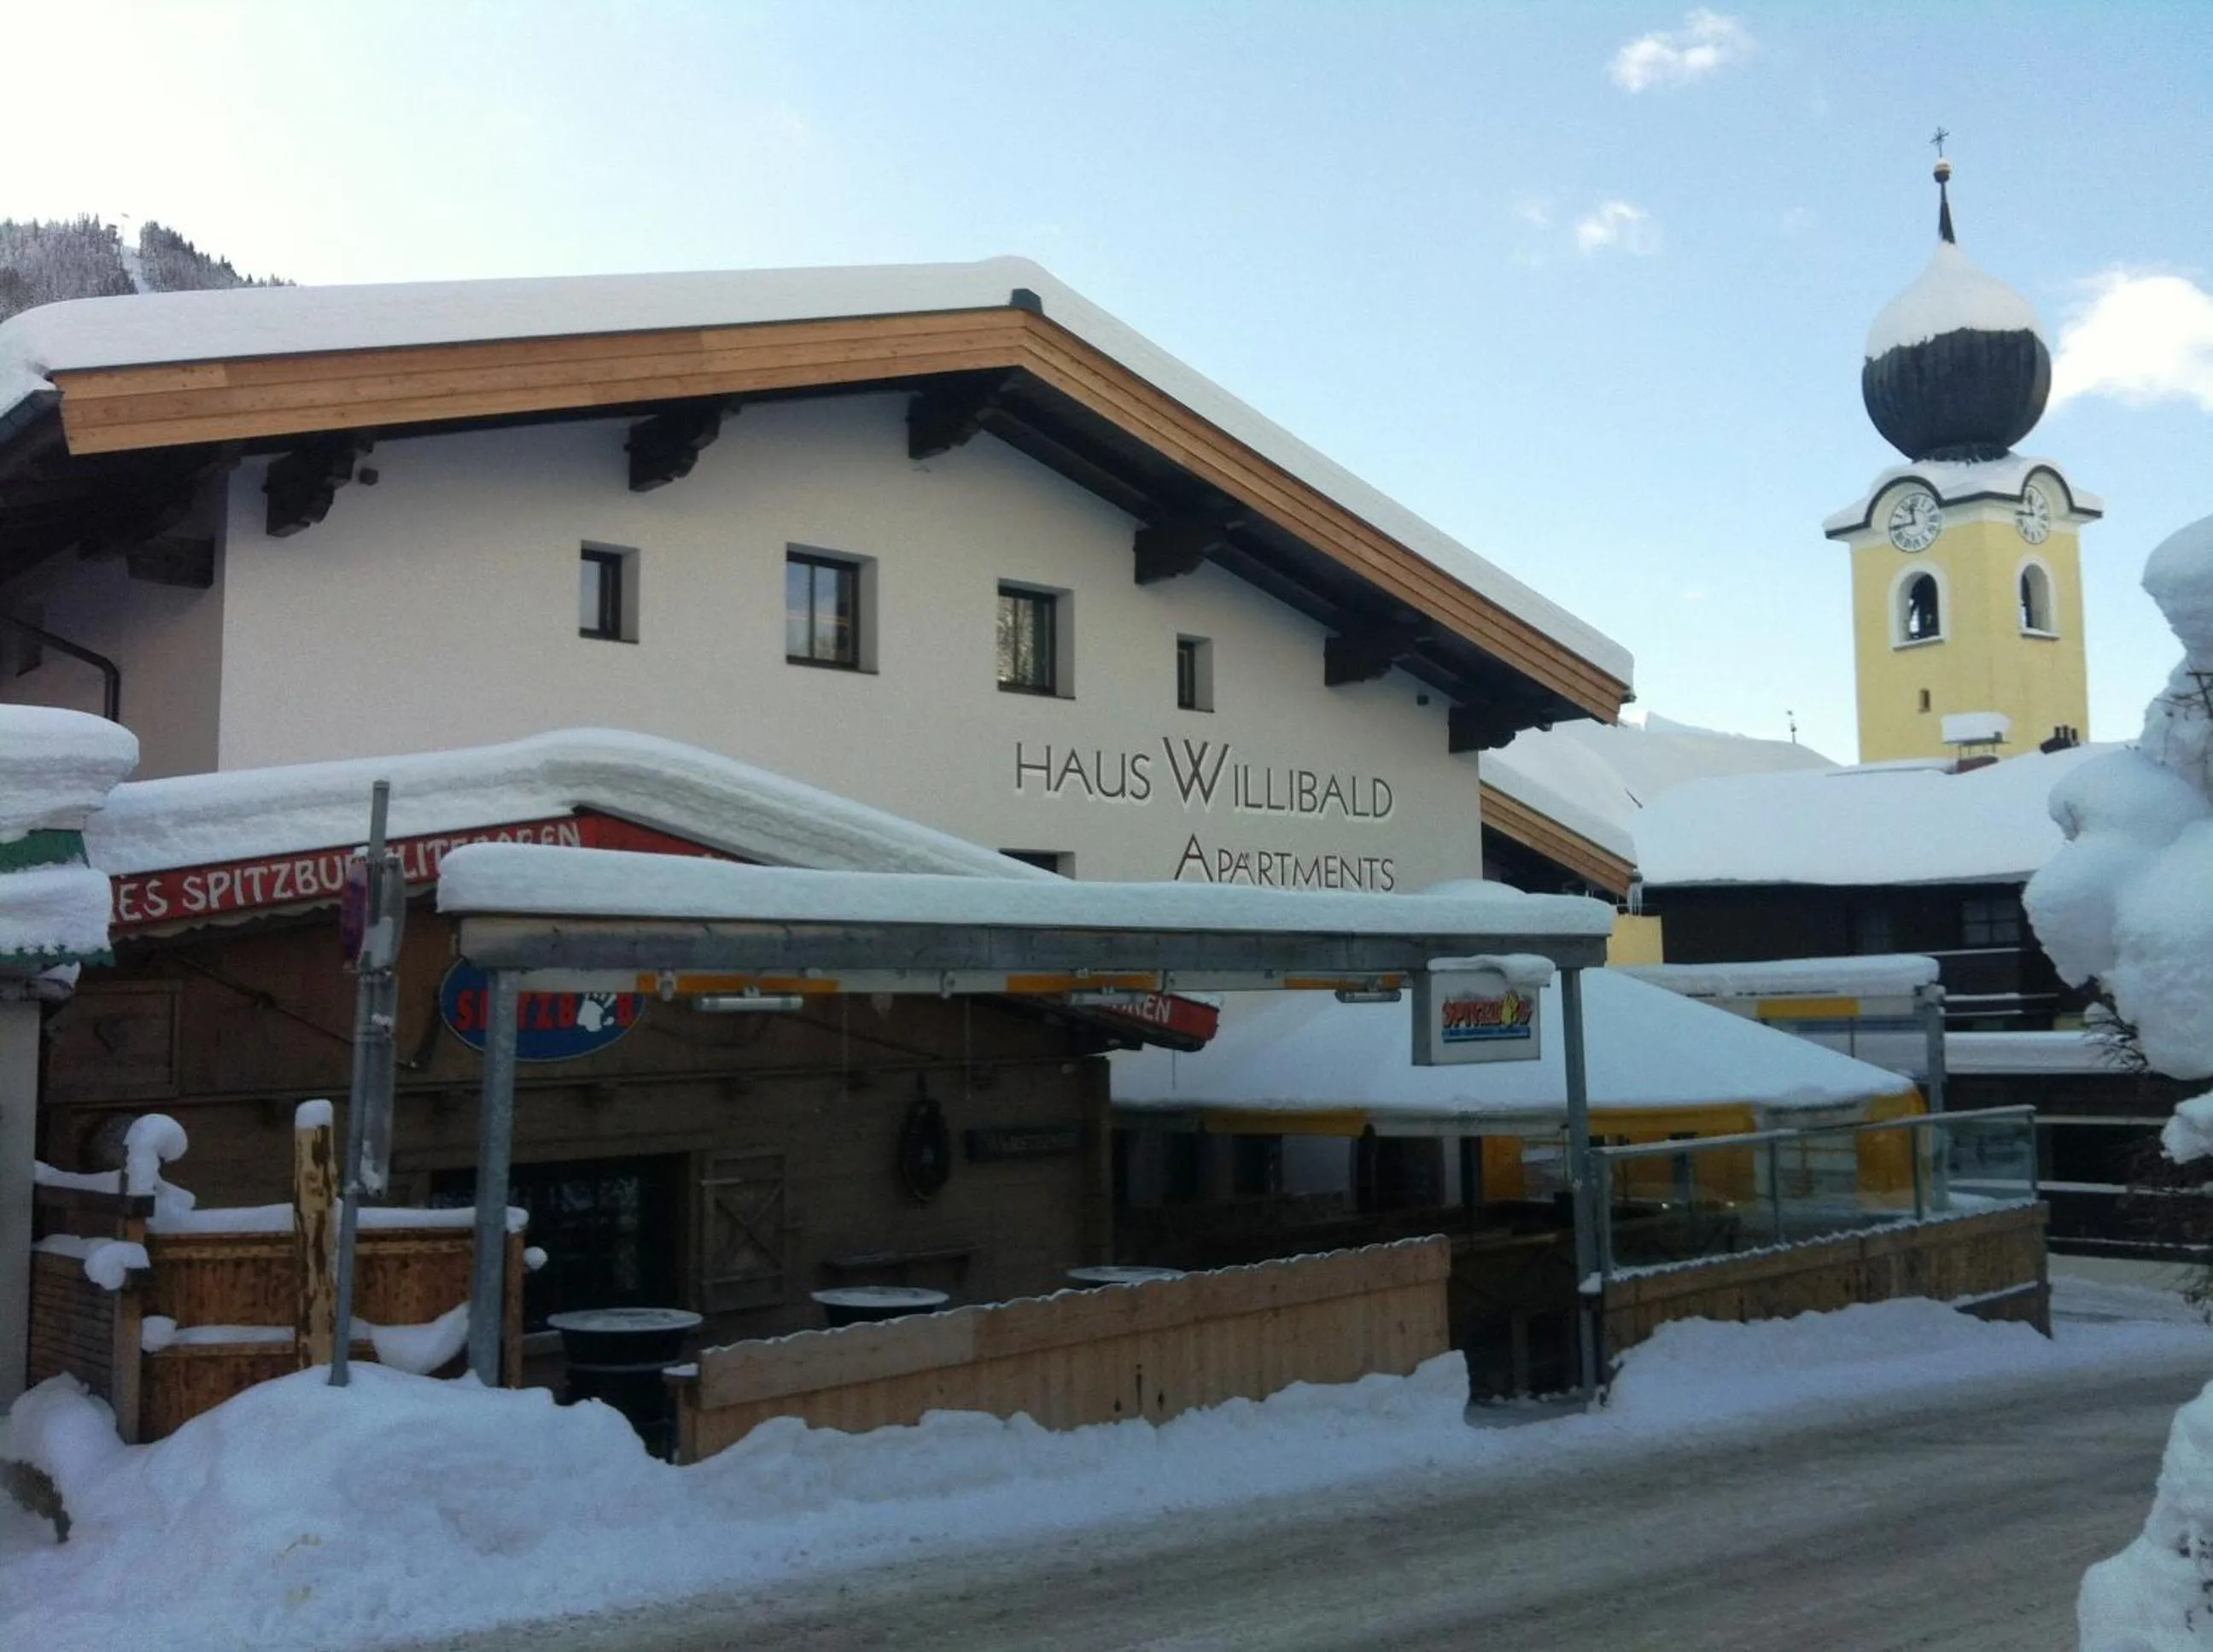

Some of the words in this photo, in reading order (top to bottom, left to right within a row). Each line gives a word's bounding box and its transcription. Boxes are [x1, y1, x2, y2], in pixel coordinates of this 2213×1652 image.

[1016, 742, 1152, 801] HAUS
[1162, 737, 1394, 818] WILLIBALD
[1173, 832, 1395, 891] APARTMENTS
